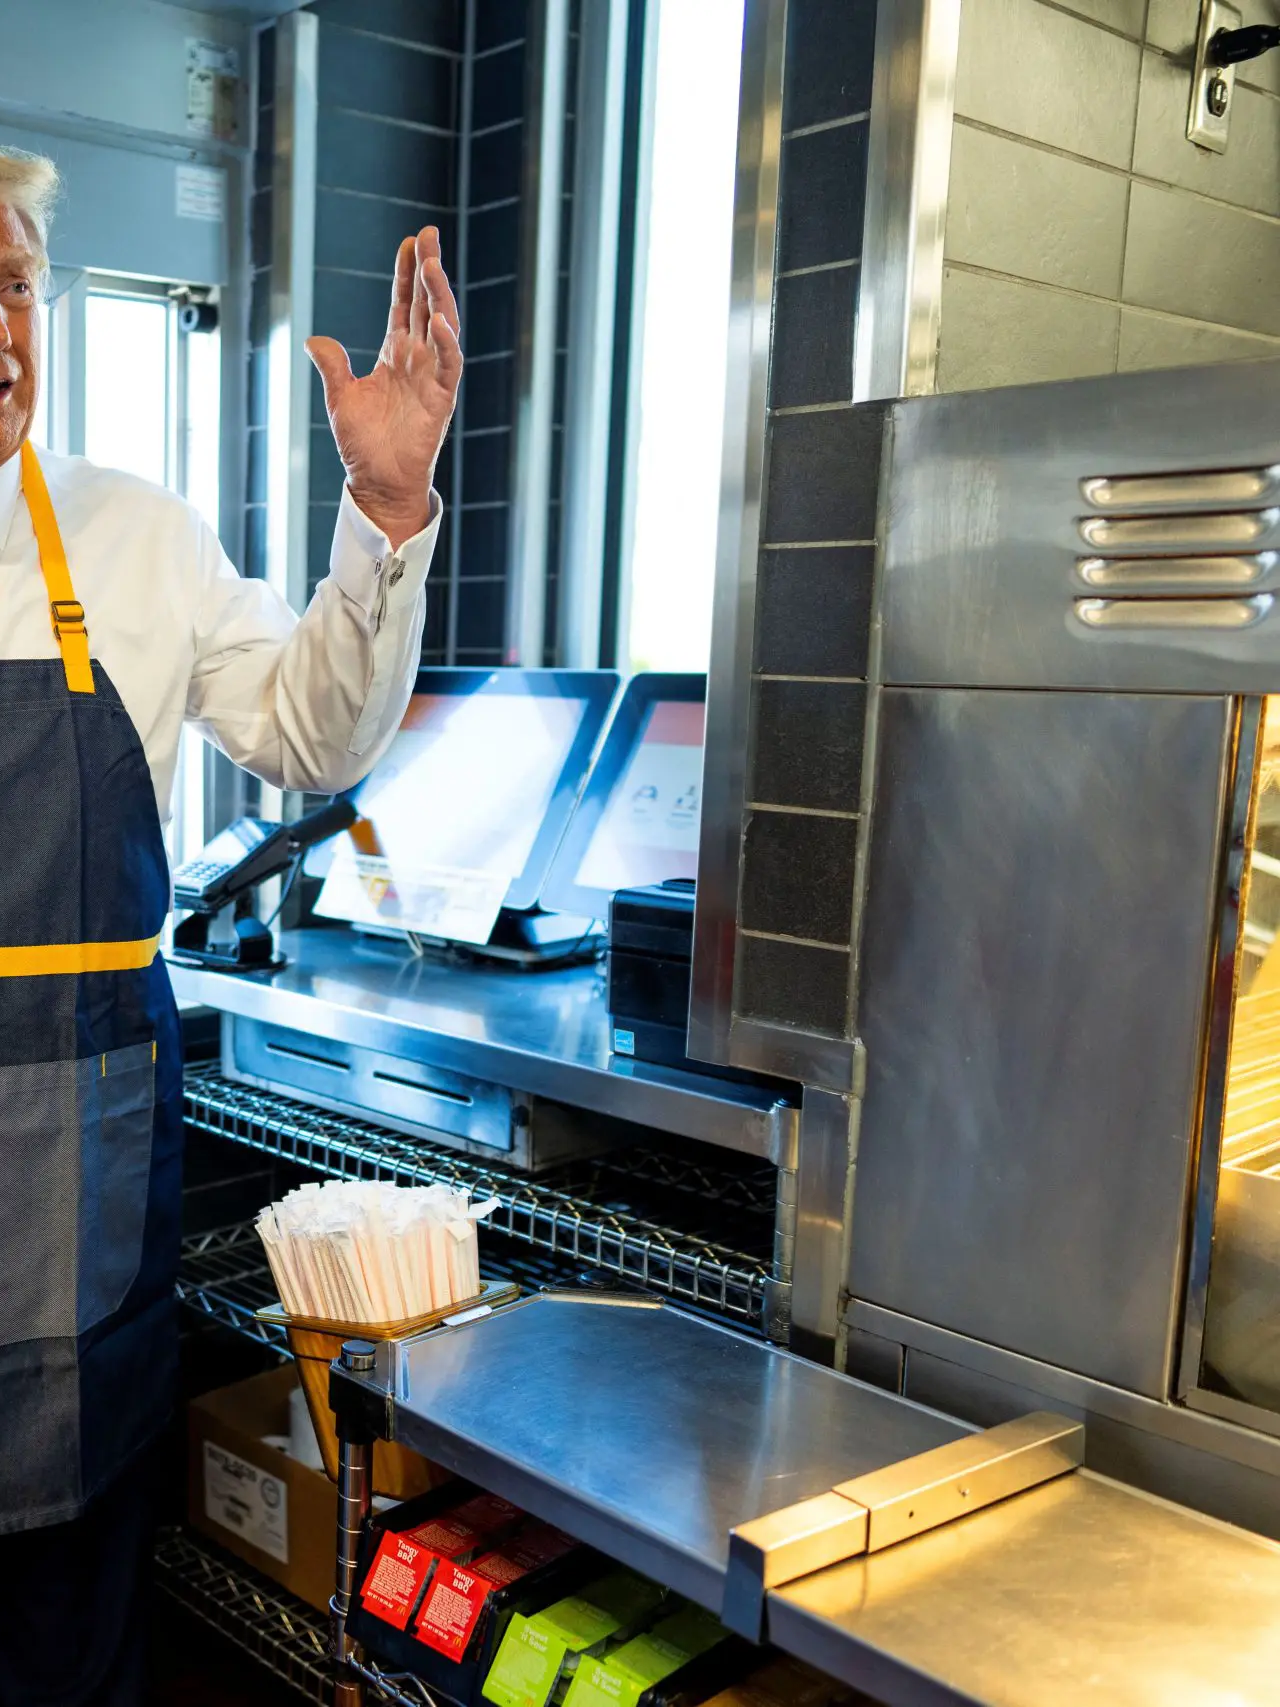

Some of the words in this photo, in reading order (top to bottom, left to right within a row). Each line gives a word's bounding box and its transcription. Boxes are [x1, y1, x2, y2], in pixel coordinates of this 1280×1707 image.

[397, 1549, 413, 1564] BBQ
[398, 1539, 418, 1557] Tangy
[453, 1568, 475, 1587] Tangy
[452, 1578, 469, 1595] BBQ
